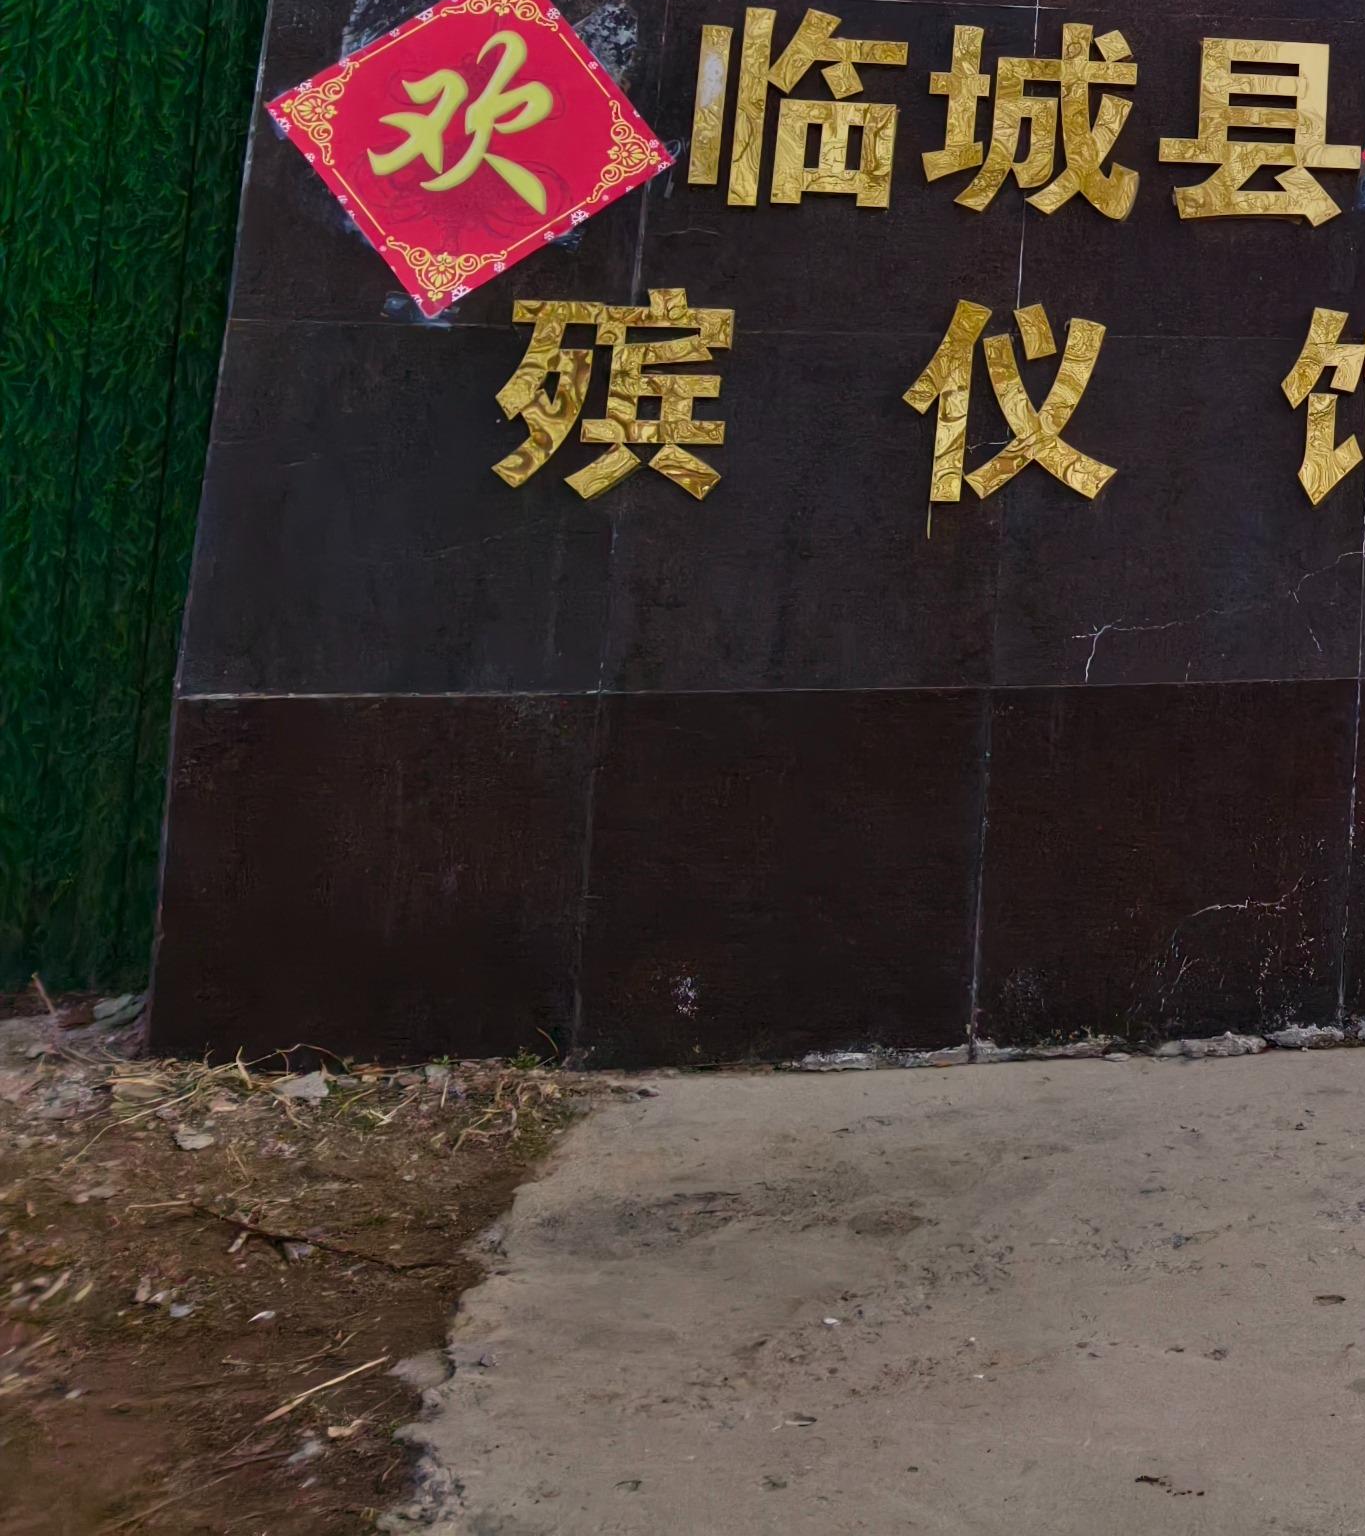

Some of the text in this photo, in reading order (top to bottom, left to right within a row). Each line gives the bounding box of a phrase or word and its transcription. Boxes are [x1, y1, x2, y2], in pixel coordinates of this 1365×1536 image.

[366, 30, 554, 215] 欢
[687, 6, 1361, 227] 临城县
